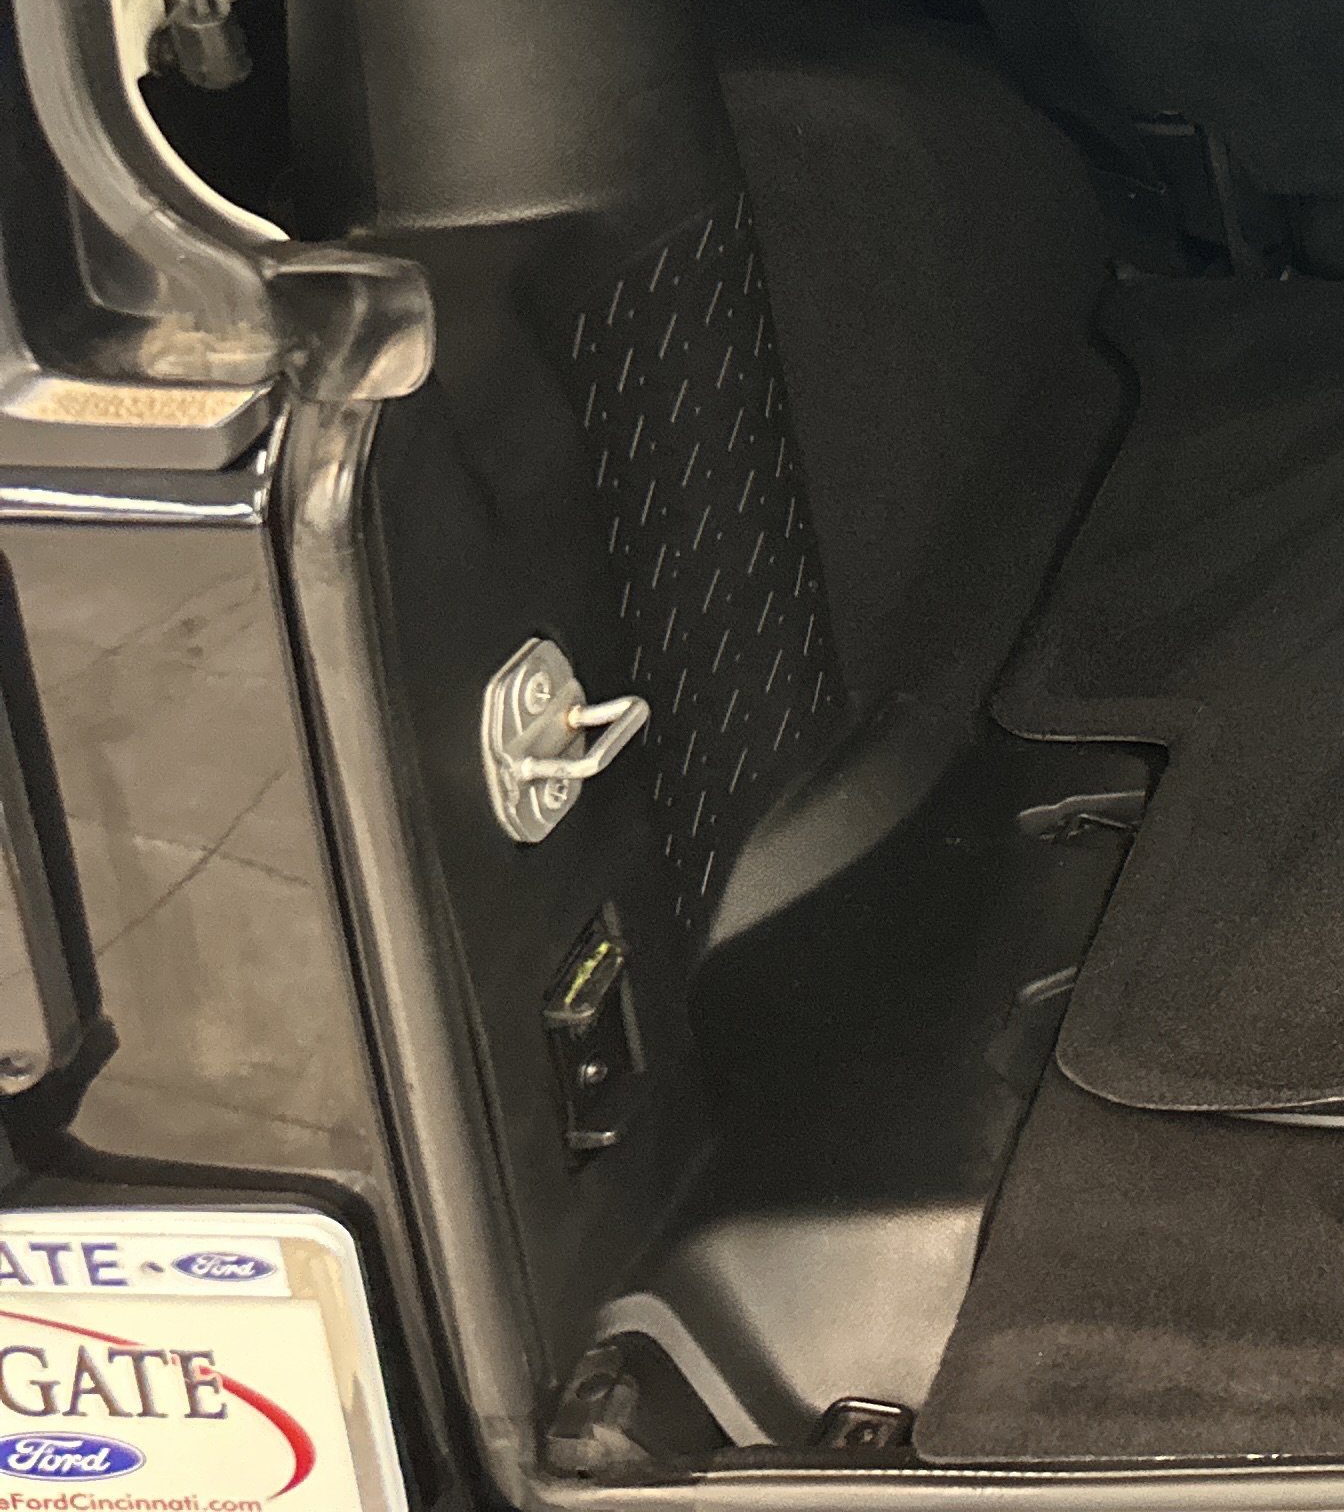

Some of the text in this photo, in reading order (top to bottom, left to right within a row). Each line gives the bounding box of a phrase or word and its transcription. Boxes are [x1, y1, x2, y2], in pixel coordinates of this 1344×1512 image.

[189, 1255, 256, 1276] Ford
[0, 1345, 229, 1419] GATE
[7, 1439, 111, 1473] Ford
